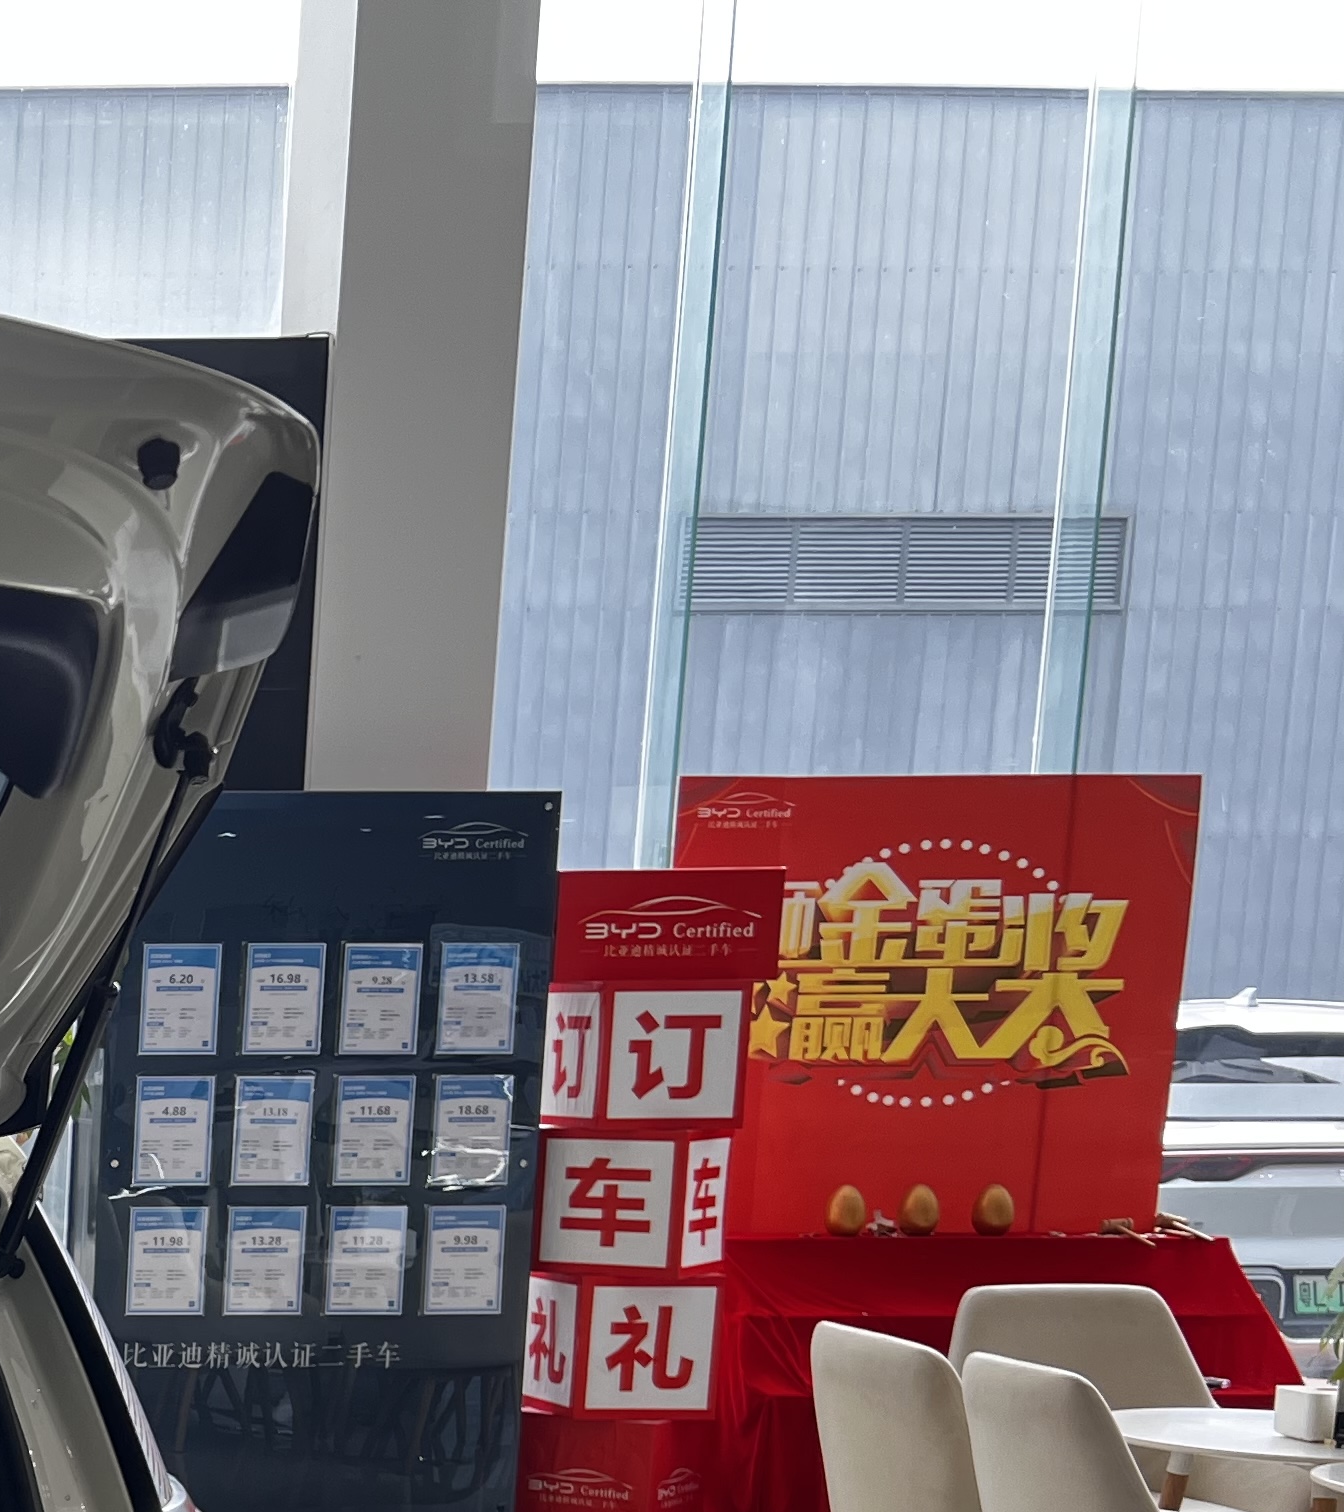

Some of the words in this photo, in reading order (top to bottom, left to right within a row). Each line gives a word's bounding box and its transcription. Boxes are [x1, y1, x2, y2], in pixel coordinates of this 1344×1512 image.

[697, 807, 741, 818] BYD
[422, 838, 469, 849] BYD
[475, 838, 525, 849] Certified
[584, 922, 662, 940] BYD
[673, 922, 755, 938] Certified
[168, 973, 194, 985] 6.20
[269, 973, 301, 984] 16.98
[463, 973, 495, 984] 13.58
[551, 1010, 592, 1099] 订
[628, 1010, 722, 1101] 订
[161, 1106, 187, 1116] 4.88
[360, 1105, 391, 1116] 11.68
[458, 1105, 489, 1115] 18.68
[559, 1157, 652, 1247] 车
[688, 1157, 721, 1247] 车
[152, 1236, 184, 1247] 11.98
[251, 1236, 282, 1246] 13.28
[453, 1235, 478, 1246] 9.98
[529, 1297, 566, 1384] 礼
[605, 1304, 694, 1392] 礼
[123, 1341, 401, 1370] 比亚迪精诚认证二手车
